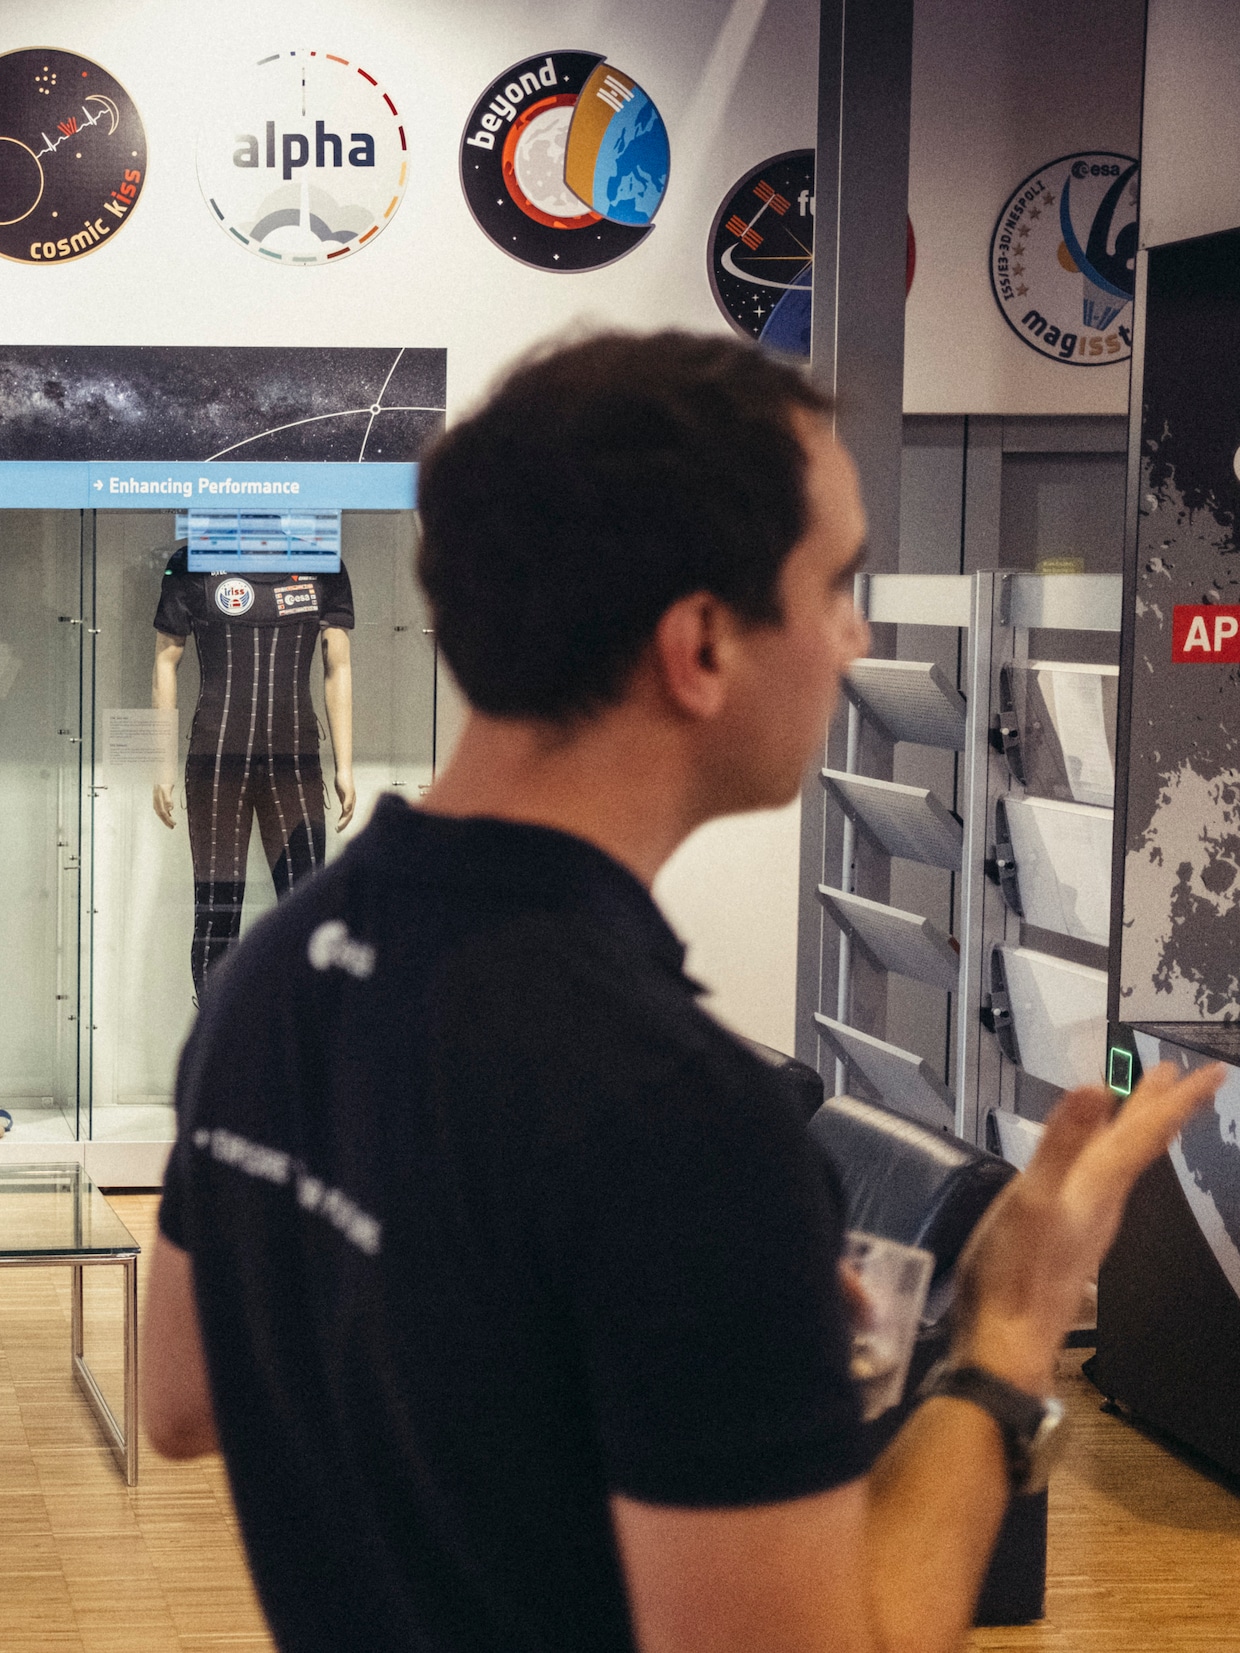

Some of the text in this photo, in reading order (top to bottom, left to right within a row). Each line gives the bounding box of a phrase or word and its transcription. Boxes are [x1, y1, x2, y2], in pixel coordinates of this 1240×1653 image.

[466, 57, 558, 150] beyond
[233, 120, 376, 180] alpha
[30, 168, 141, 259] cosmic kiss
[109, 477, 300, 498] Enhancing Performance
[224, 587, 245, 597] iriss
[1183, 616, 1240, 652] AP
